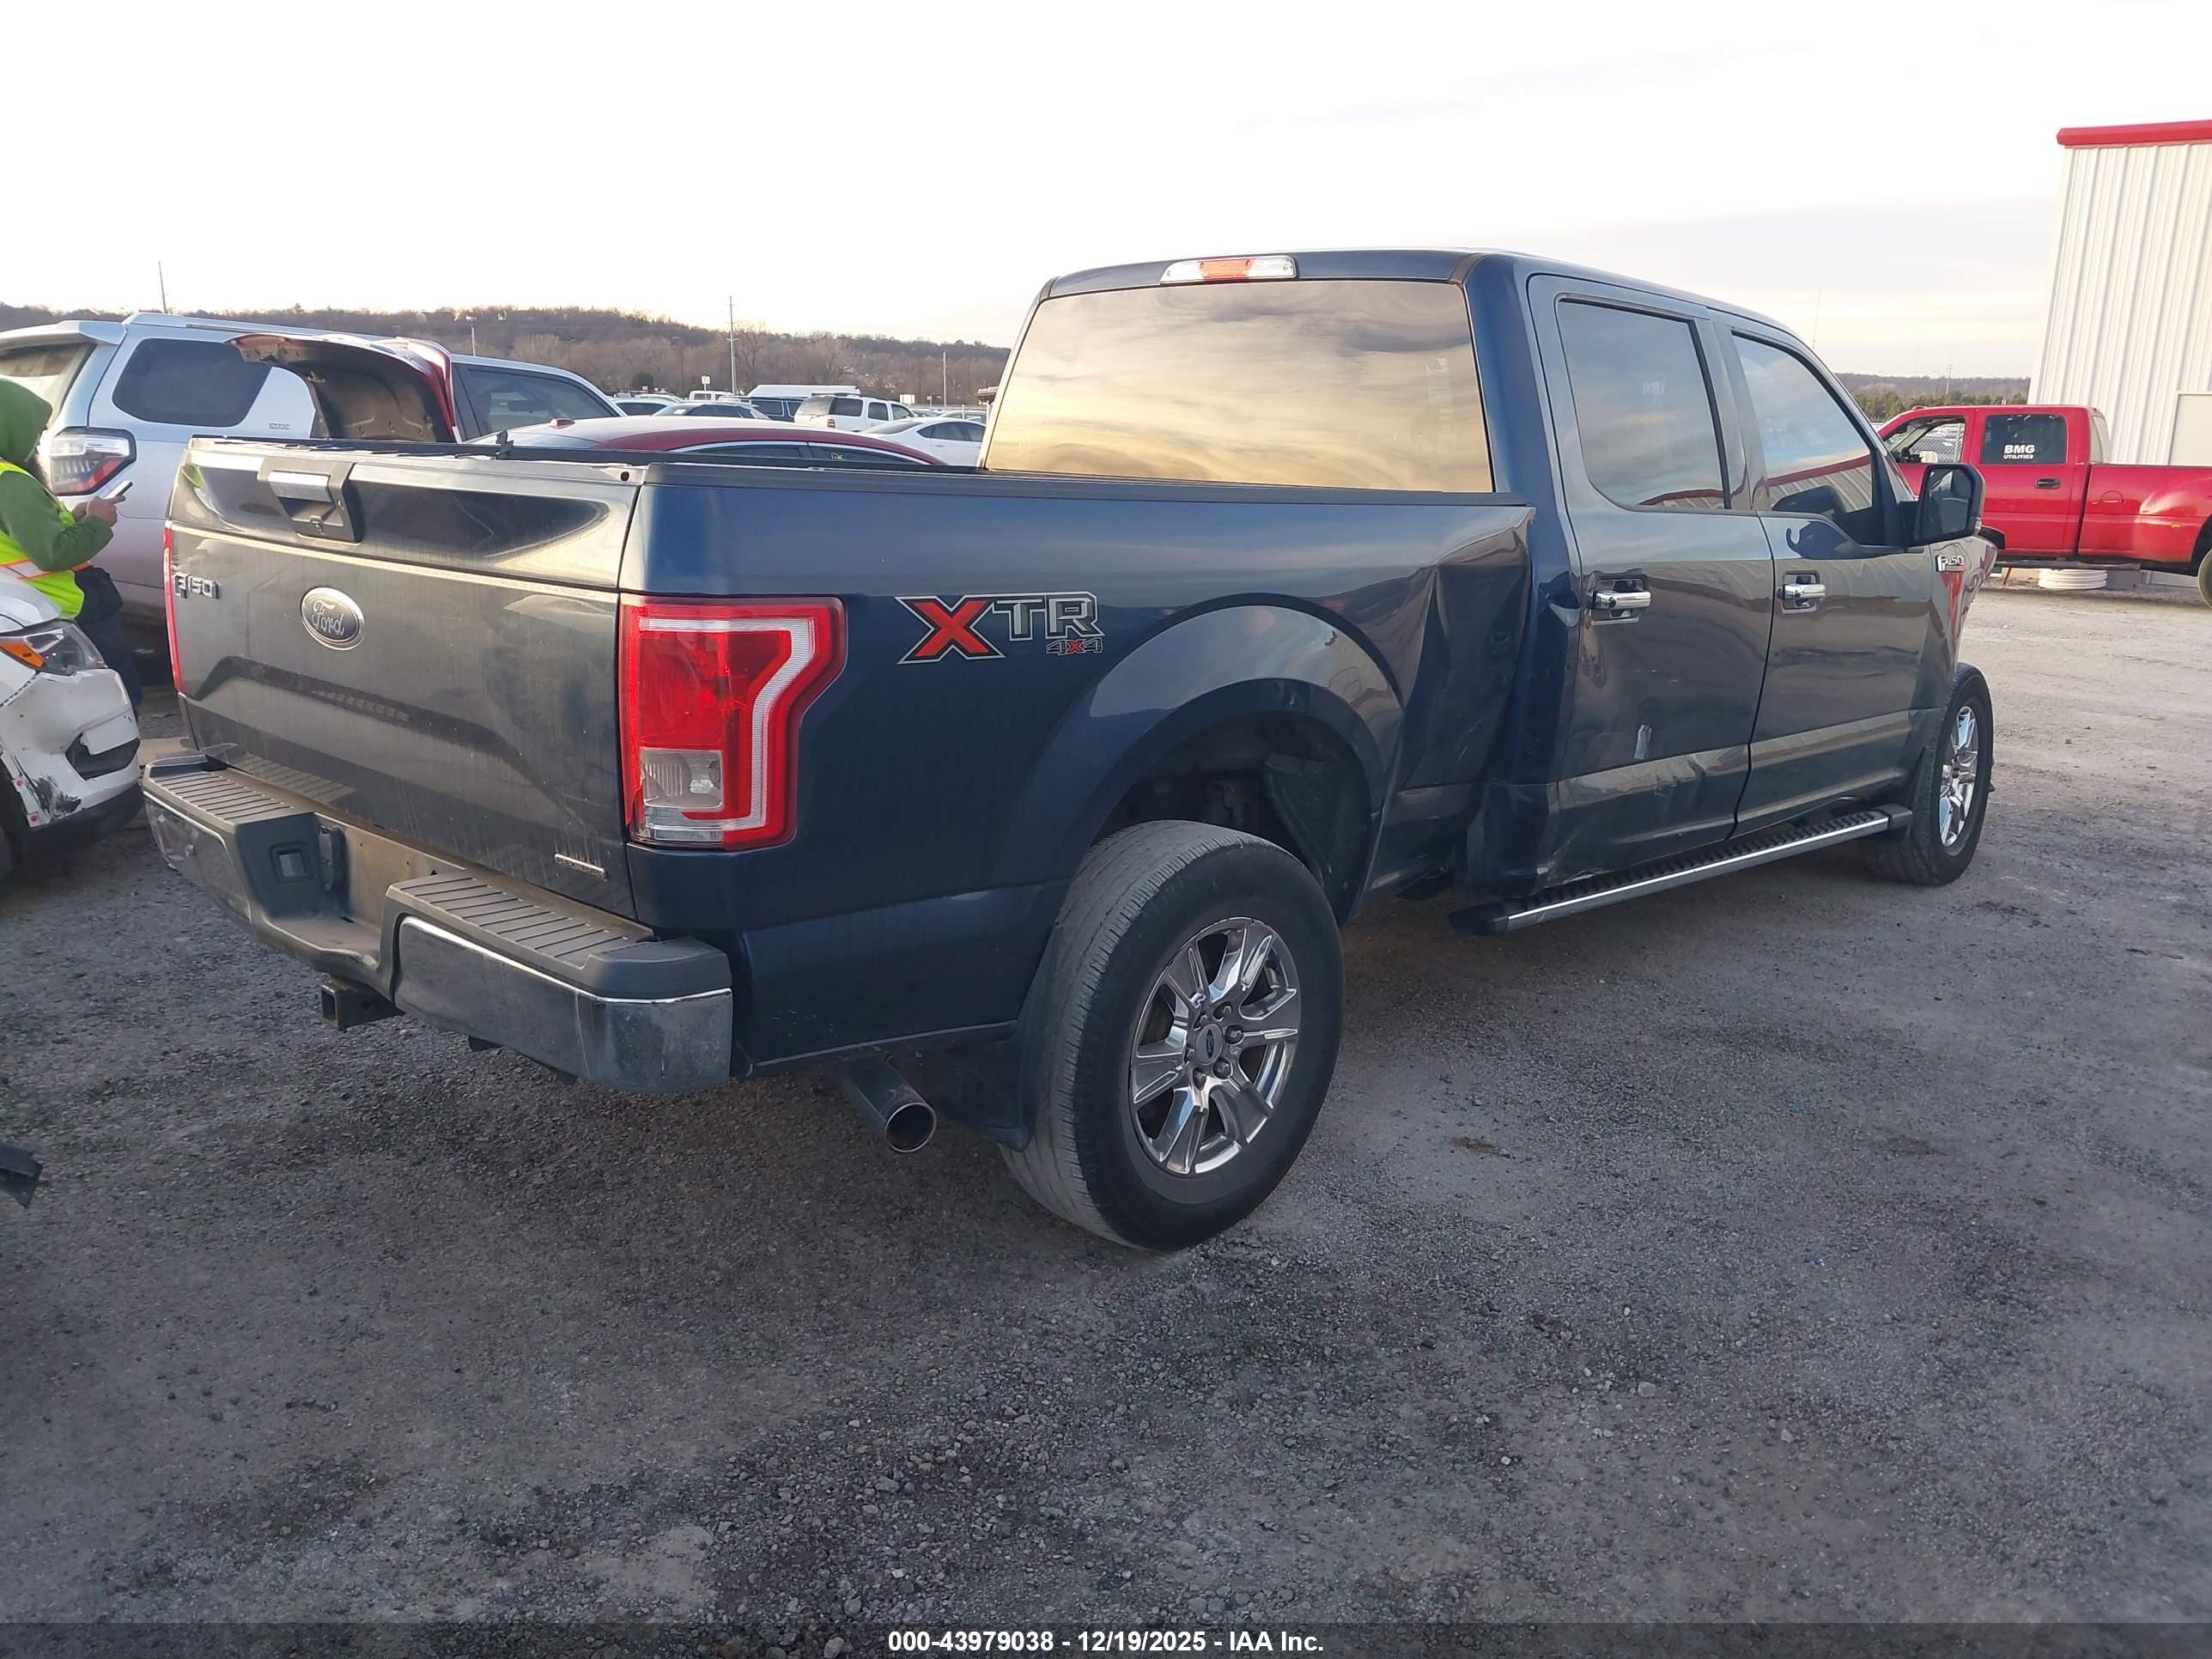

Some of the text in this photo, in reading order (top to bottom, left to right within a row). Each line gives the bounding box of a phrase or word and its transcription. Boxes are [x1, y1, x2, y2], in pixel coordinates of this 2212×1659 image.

[2003, 444, 2035, 454] BMG
[311, 599, 345, 636] Ford
[894, 592, 1105, 665] XTR
